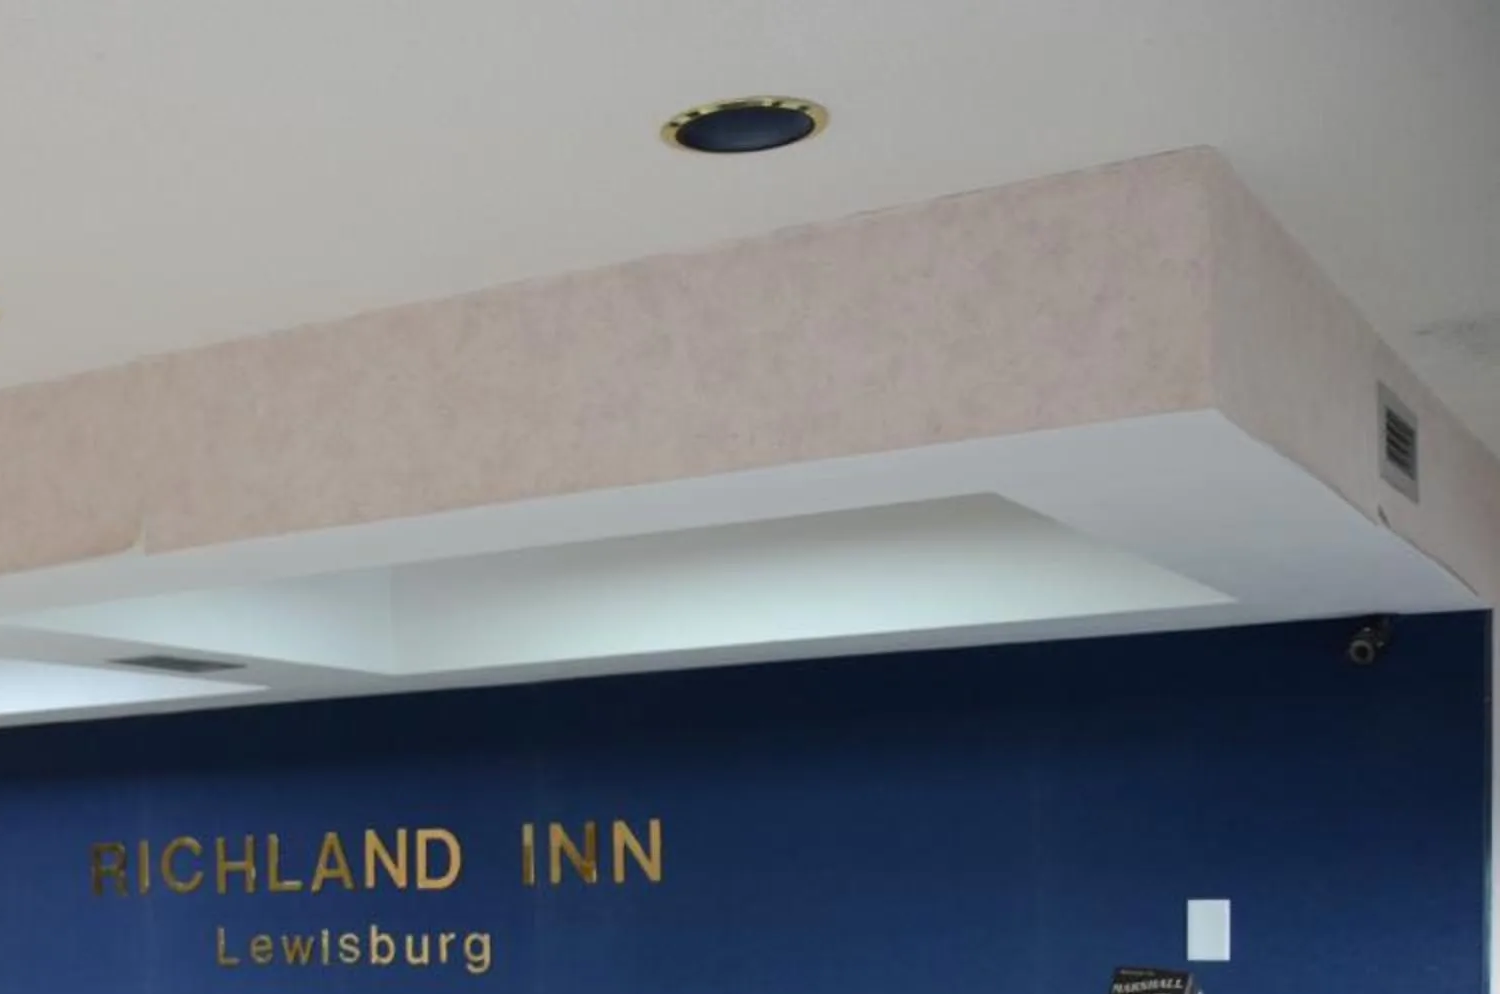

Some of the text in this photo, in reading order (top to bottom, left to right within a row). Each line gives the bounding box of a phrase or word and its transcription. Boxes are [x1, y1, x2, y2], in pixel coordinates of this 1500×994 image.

[91, 818, 663, 896] RICHLAND INN
[216, 924, 493, 974] Lewisburg
[1112, 979, 1183, 994] MARSHALL
